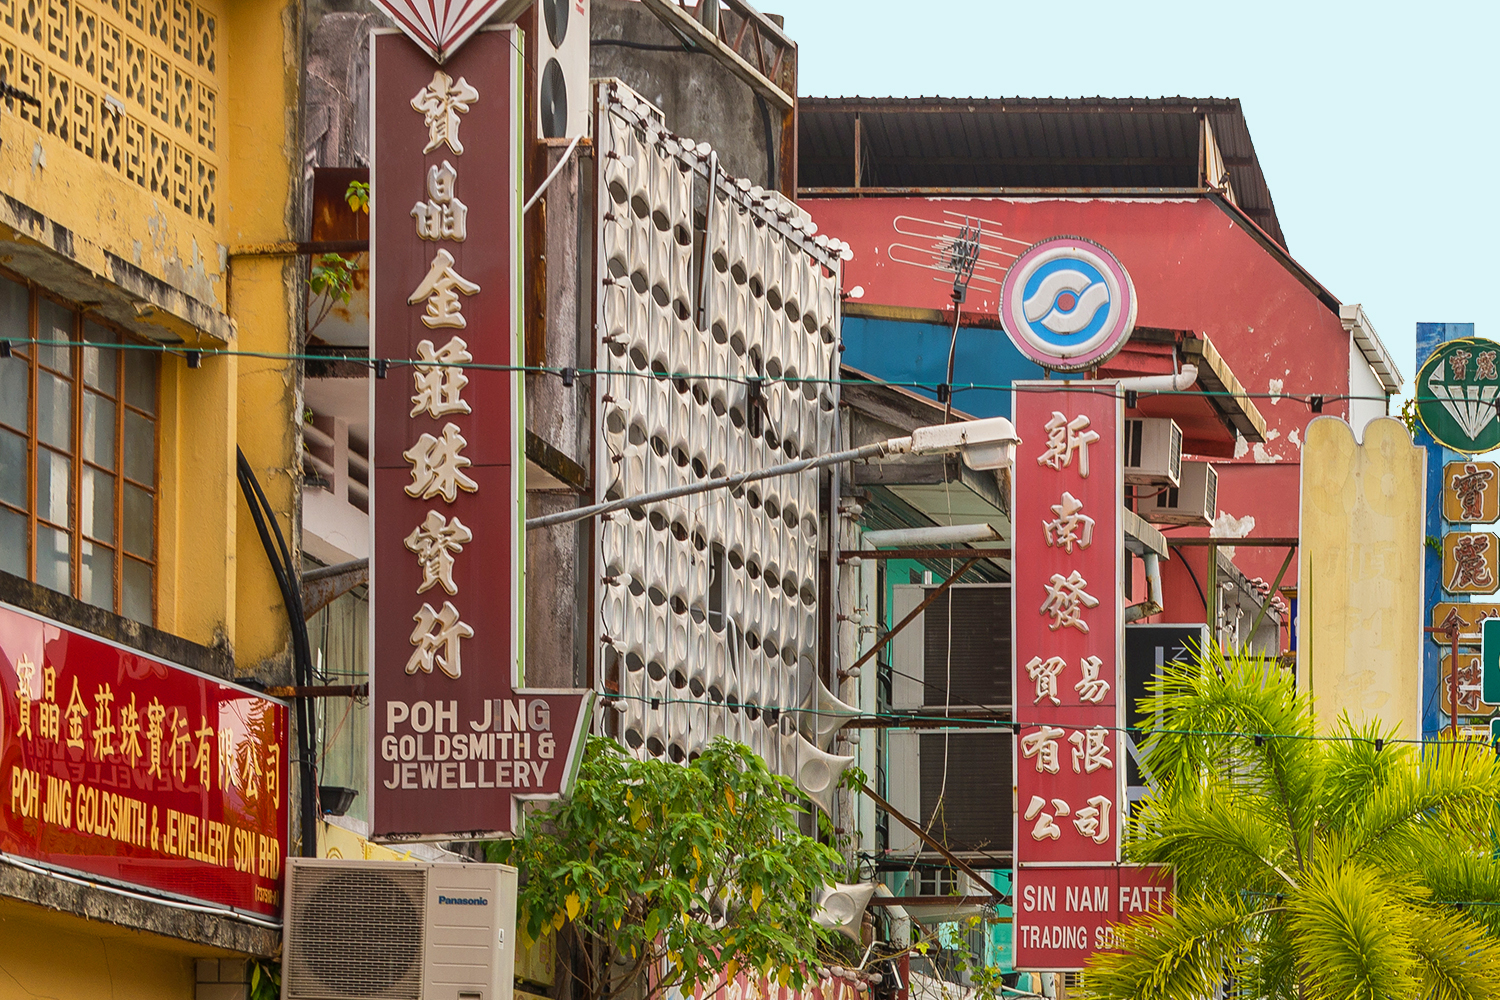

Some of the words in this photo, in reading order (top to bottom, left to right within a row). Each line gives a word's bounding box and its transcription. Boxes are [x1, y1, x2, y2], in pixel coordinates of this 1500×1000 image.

[386, 700, 458, 734] POH
[469, 699, 550, 733] JING
[381, 733, 531, 762] GOLDSMITH
[537, 732, 556, 760] &
[1021, 725, 1113, 775] 有限
[383, 761, 549, 789] JEWELLERY
[11, 765, 39, 819] POH
[43, 775, 72, 829] JING
[76, 785, 147, 848] GOLDSMITH
[151, 805, 160, 851] &
[163, 808, 231, 869] JEWELLERY
[234, 829, 256, 875] SDN
[259, 834, 280, 881] BHD
[1023, 795, 1111, 846] 公司
[438, 895, 488, 906] Panasonic
[1023, 885, 1056, 912] SIN
[1065, 886, 1109, 912] NAM
[1119, 886, 1166, 912] FATT
[1021, 925, 1087, 949] TRADING
